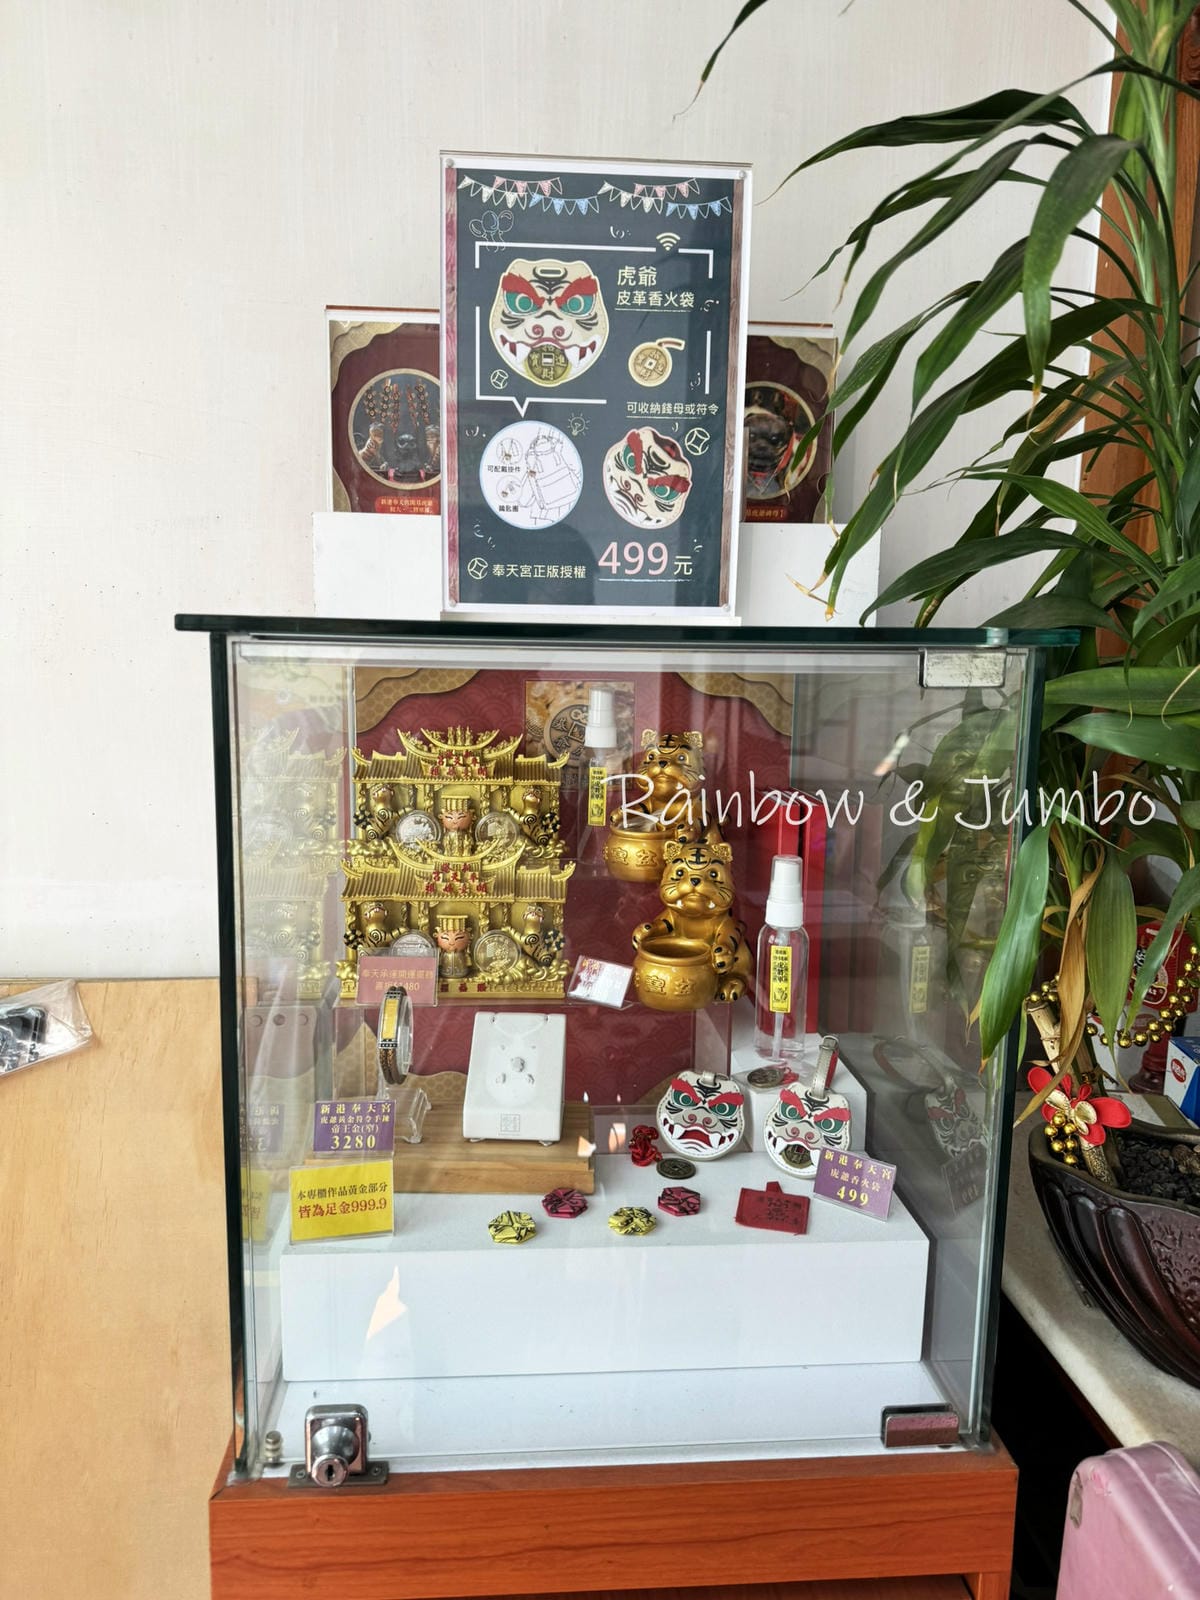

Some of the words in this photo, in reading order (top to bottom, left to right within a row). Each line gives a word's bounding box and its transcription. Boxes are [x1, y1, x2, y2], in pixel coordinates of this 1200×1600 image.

[617, 265, 658, 287] 虎爺
[616, 290, 696, 308] 皮革香火袋
[626, 401, 720, 416] 可收納錢母或符令
[597, 541, 670, 576] 499
[673, 554, 694, 576] 元
[492, 563, 588, 580] 奉天宮正版授權
[320, 1103, 391, 1115] 新港奉天宮
[330, 1135, 376, 1150] 3280
[824, 1149, 893, 1180] 新港奉天宮
[836, 1185, 869, 1207] 499
[298, 1197, 388, 1219] 皆為足金999.9
